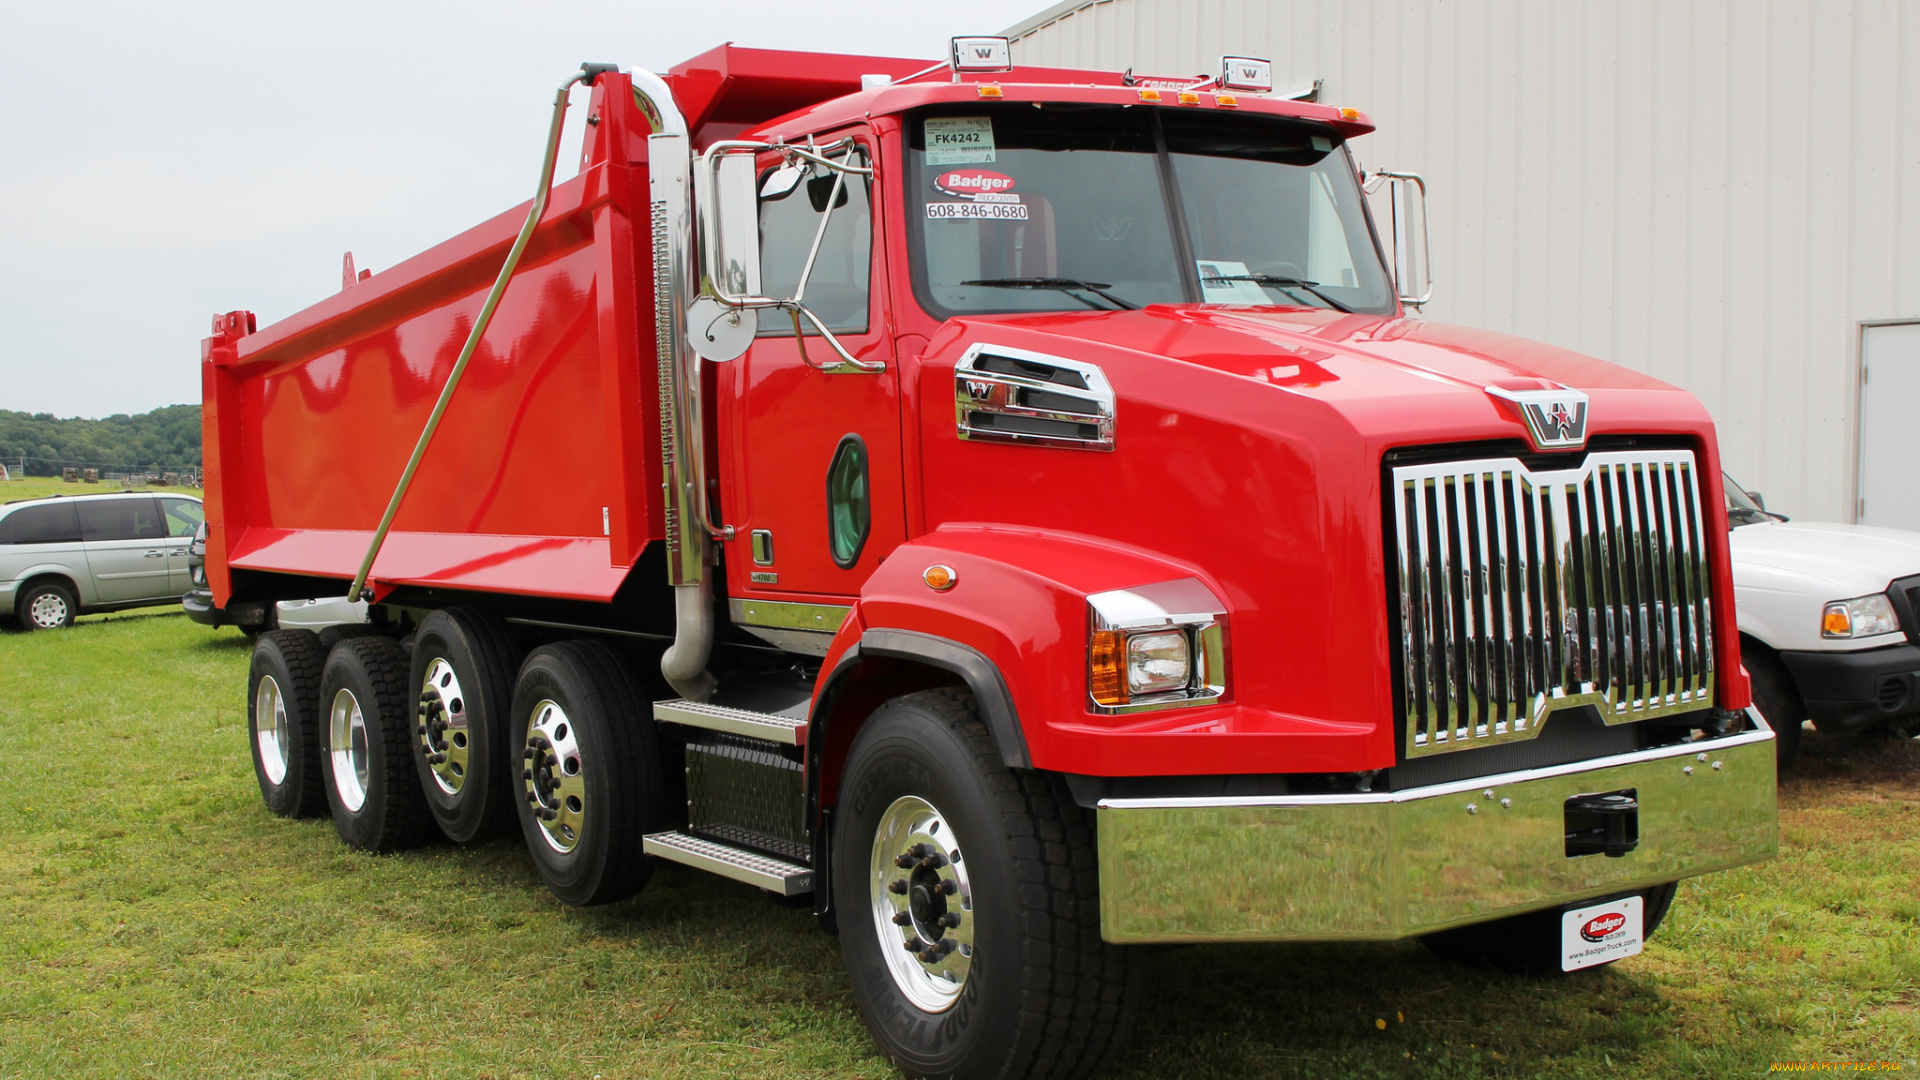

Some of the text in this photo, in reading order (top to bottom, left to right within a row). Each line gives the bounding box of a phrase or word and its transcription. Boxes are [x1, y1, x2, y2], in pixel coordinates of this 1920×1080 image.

[935, 133, 981, 144] FK4242
[984, 154, 992, 162] A
[948, 174, 1011, 191] Badger
[927, 204, 1027, 219] 608-846-0680
[1589, 917, 1624, 933] Badger
[1568, 938, 1637, 960] www.BadgerTruck.com
